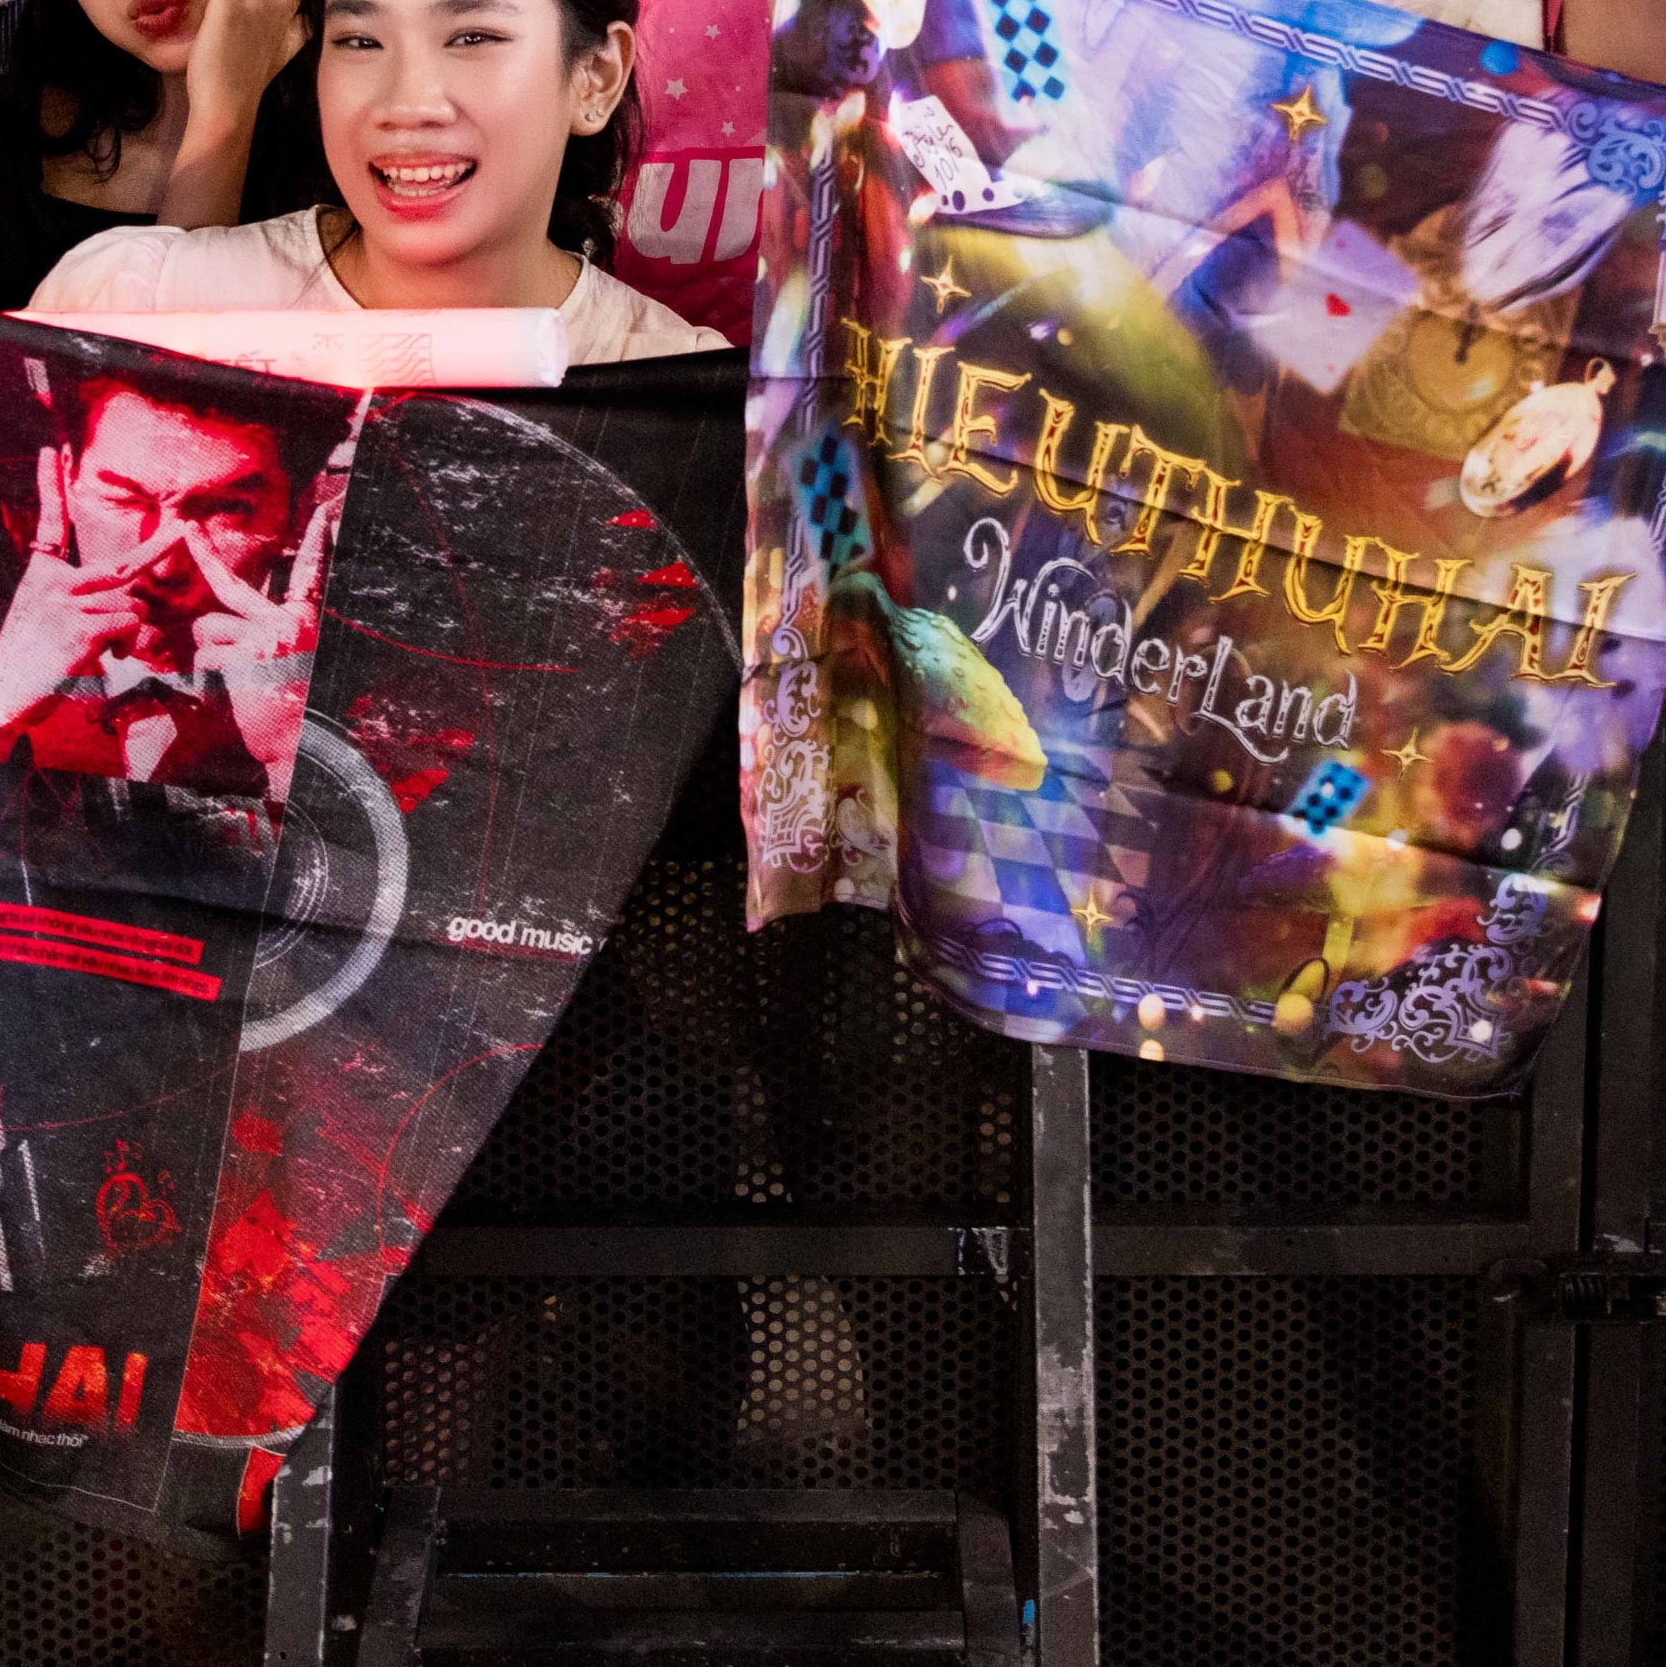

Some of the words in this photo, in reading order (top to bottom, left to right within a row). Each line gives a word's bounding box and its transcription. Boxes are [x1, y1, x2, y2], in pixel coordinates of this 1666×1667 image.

[840, 315, 1637, 689] HIEUTHUHAI
[446, 916, 517, 944] good
[520, 927, 593, 955] music
